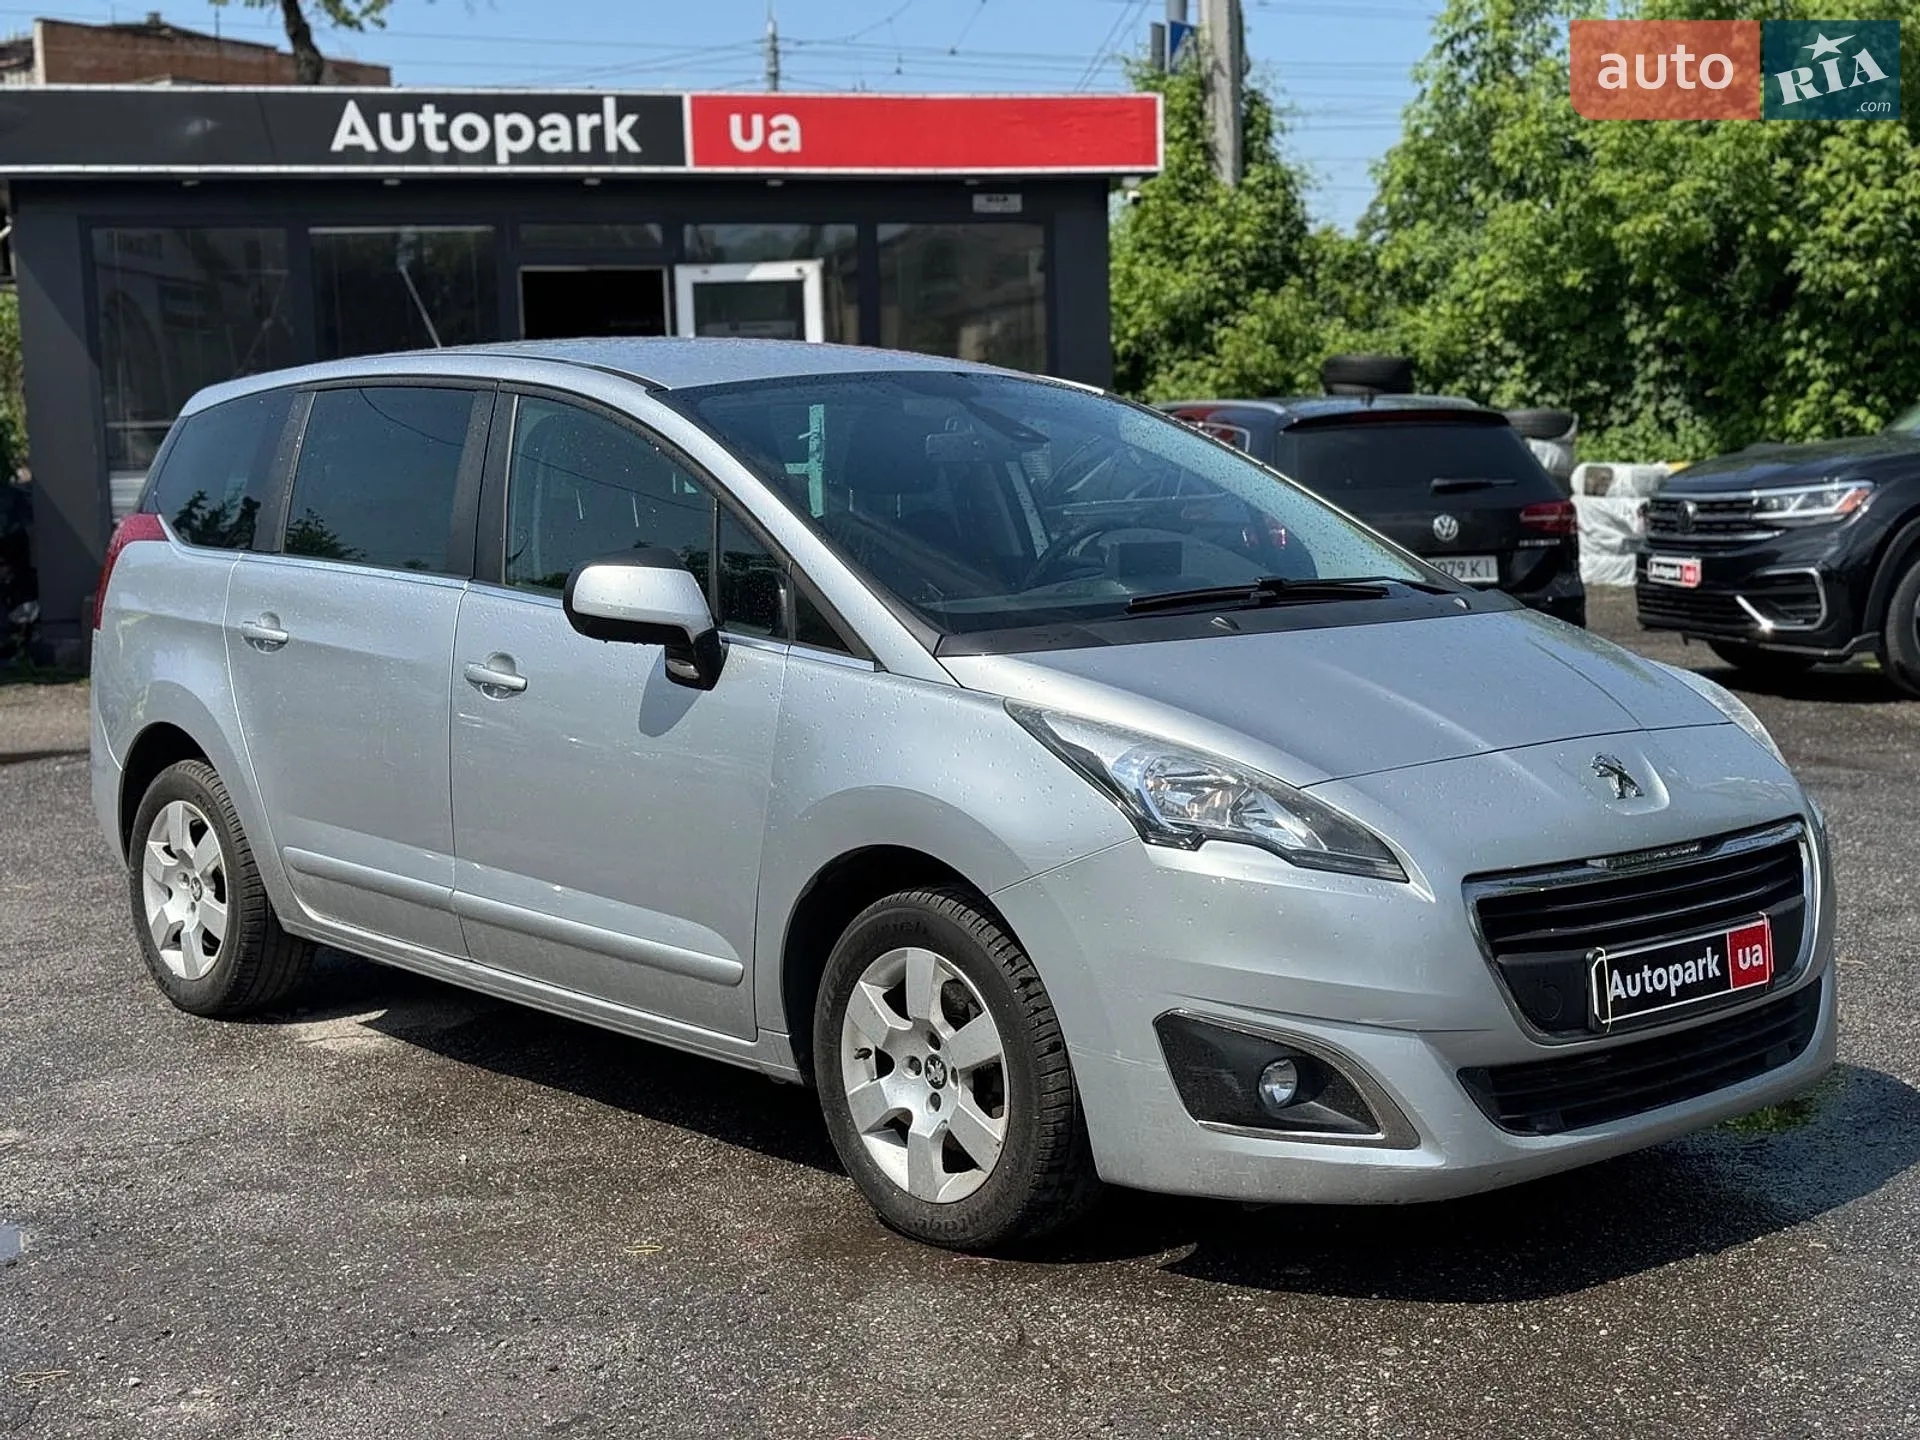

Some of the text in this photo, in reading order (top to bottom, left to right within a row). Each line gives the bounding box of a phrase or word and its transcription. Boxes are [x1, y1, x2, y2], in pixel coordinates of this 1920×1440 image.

[330, 95, 801, 165] Autopark ua
[1431, 560, 1466, 578] 079
[1609, 943, 1764, 1001] Autopark ua
